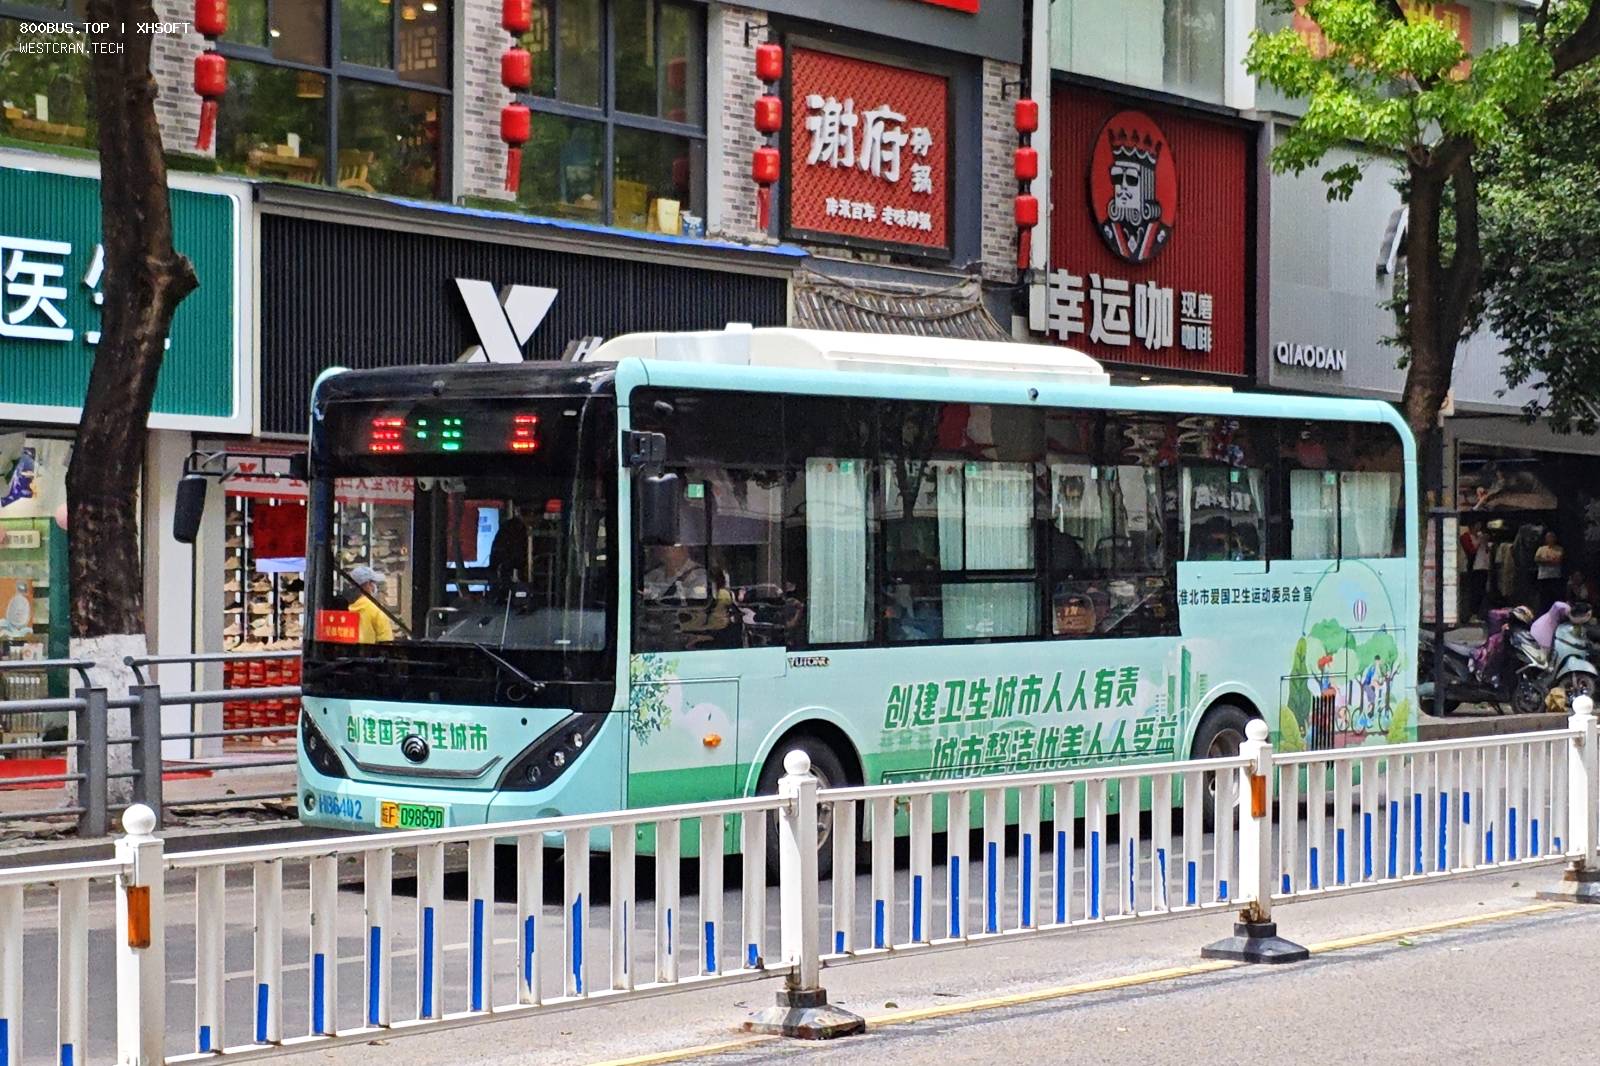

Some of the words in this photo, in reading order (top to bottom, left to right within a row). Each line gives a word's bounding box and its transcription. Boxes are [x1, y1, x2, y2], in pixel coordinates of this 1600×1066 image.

[805, 94, 908, 182] 谢府
[1044, 267, 1174, 350] 幸运咖
[1181, 291, 1213, 320] 现磨
[1181, 324, 1213, 353] 咖啡
[1276, 341, 1347, 371] QIAODAN
[787, 656, 830, 669] YUTONG
[884, 665, 1141, 730] 创建卫生城市人人有责
